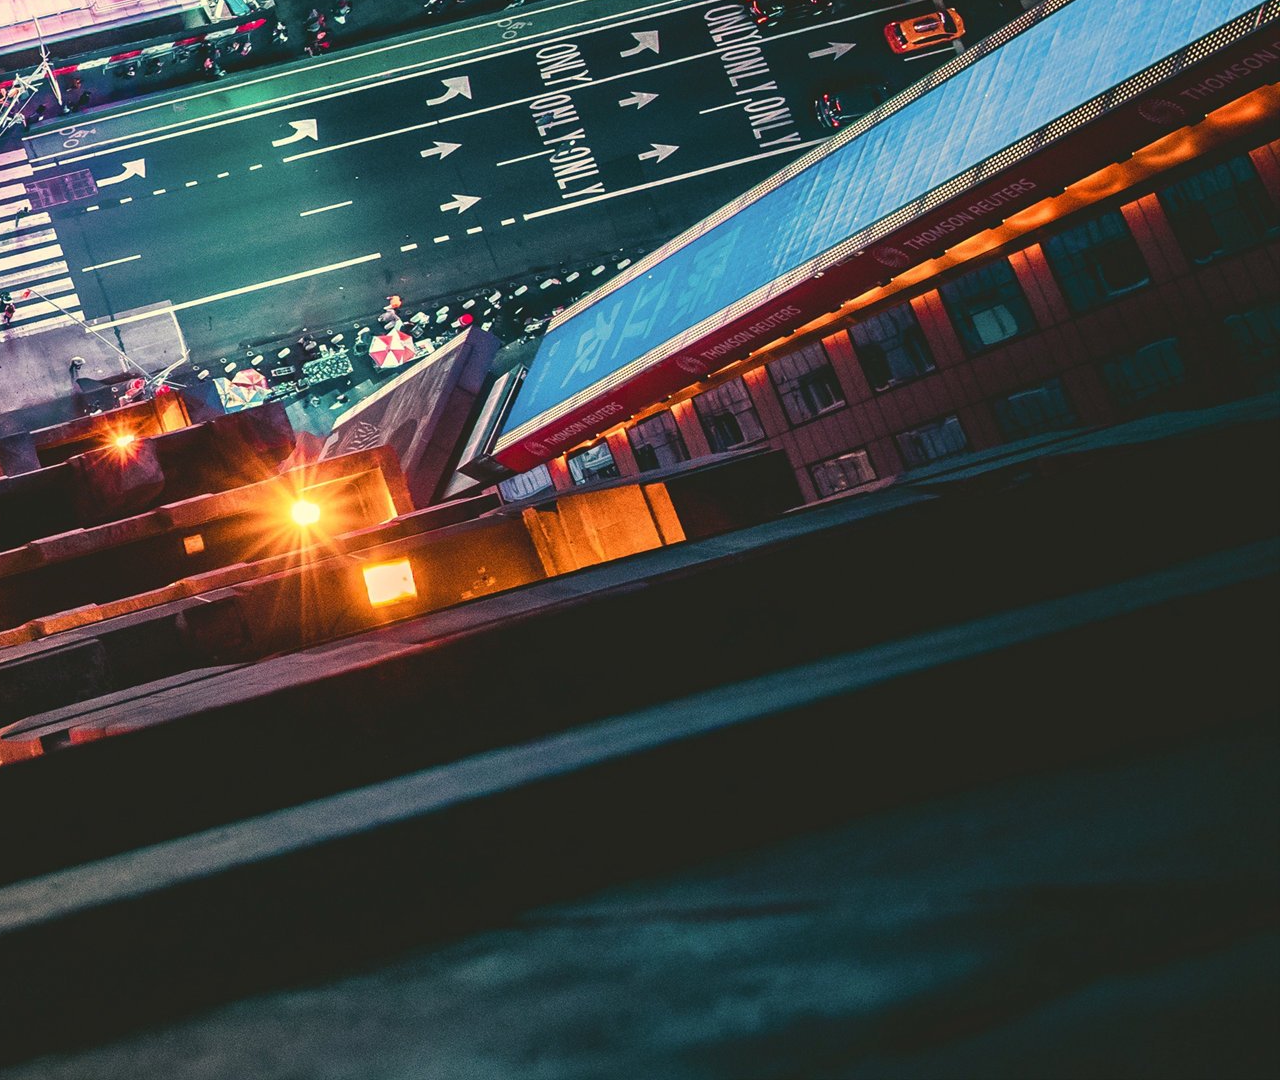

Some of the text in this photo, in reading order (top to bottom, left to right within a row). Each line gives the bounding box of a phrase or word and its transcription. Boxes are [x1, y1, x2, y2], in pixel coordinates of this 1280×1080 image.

[704, 3, 763, 48] ONLY
[536, 43, 593, 87] ONLY
[720, 46, 779, 97] ONLY
[1179, 50, 1272, 103] THOMSON
[529, 94, 586, 146] ONLY
[744, 96, 802, 149] ONLY
[903, 177, 1038, 251] THOMSON REUTERS
[700, 305, 802, 361] THOMSON REUTERS
[543, 401, 624, 448] THOMSON REUTERS
